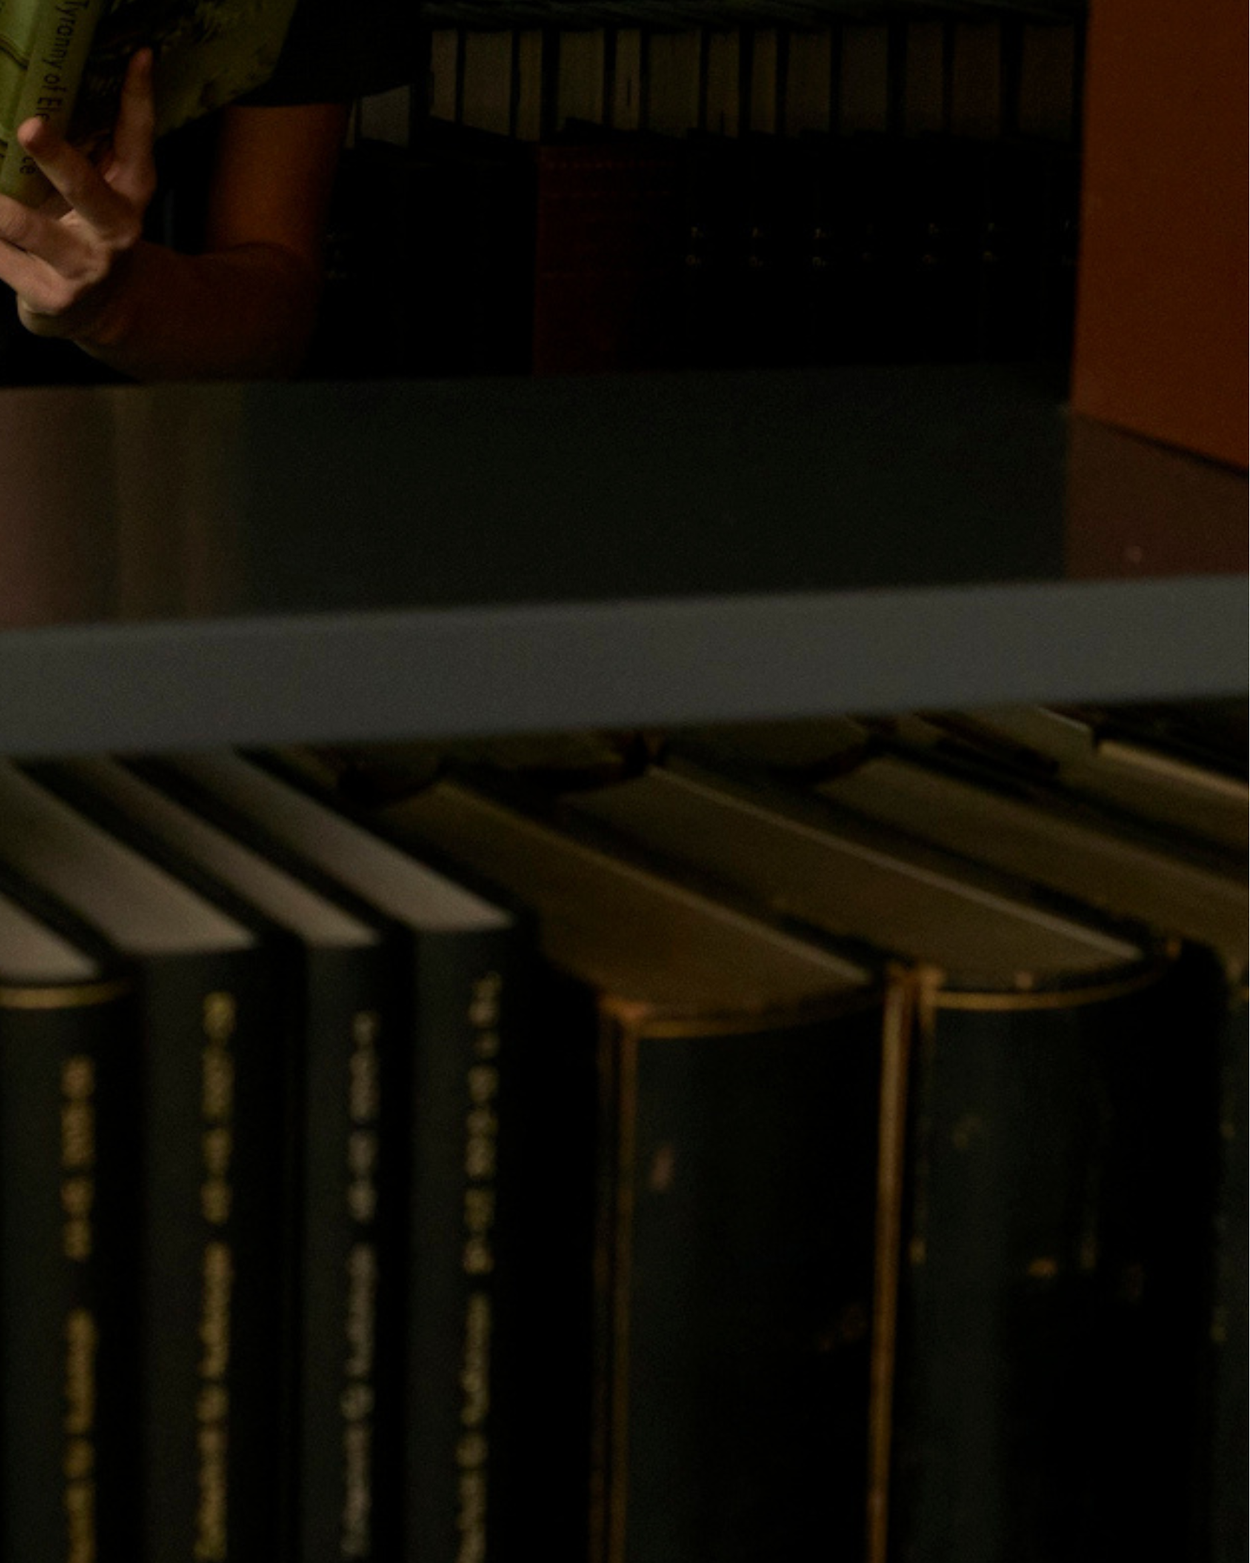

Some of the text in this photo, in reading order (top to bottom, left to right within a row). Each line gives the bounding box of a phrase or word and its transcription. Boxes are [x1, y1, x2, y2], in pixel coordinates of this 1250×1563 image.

[43, 0, 90, 68] Tyranny
[41, 73, 66, 92] of
[20, 97, 64, 175] Elece
